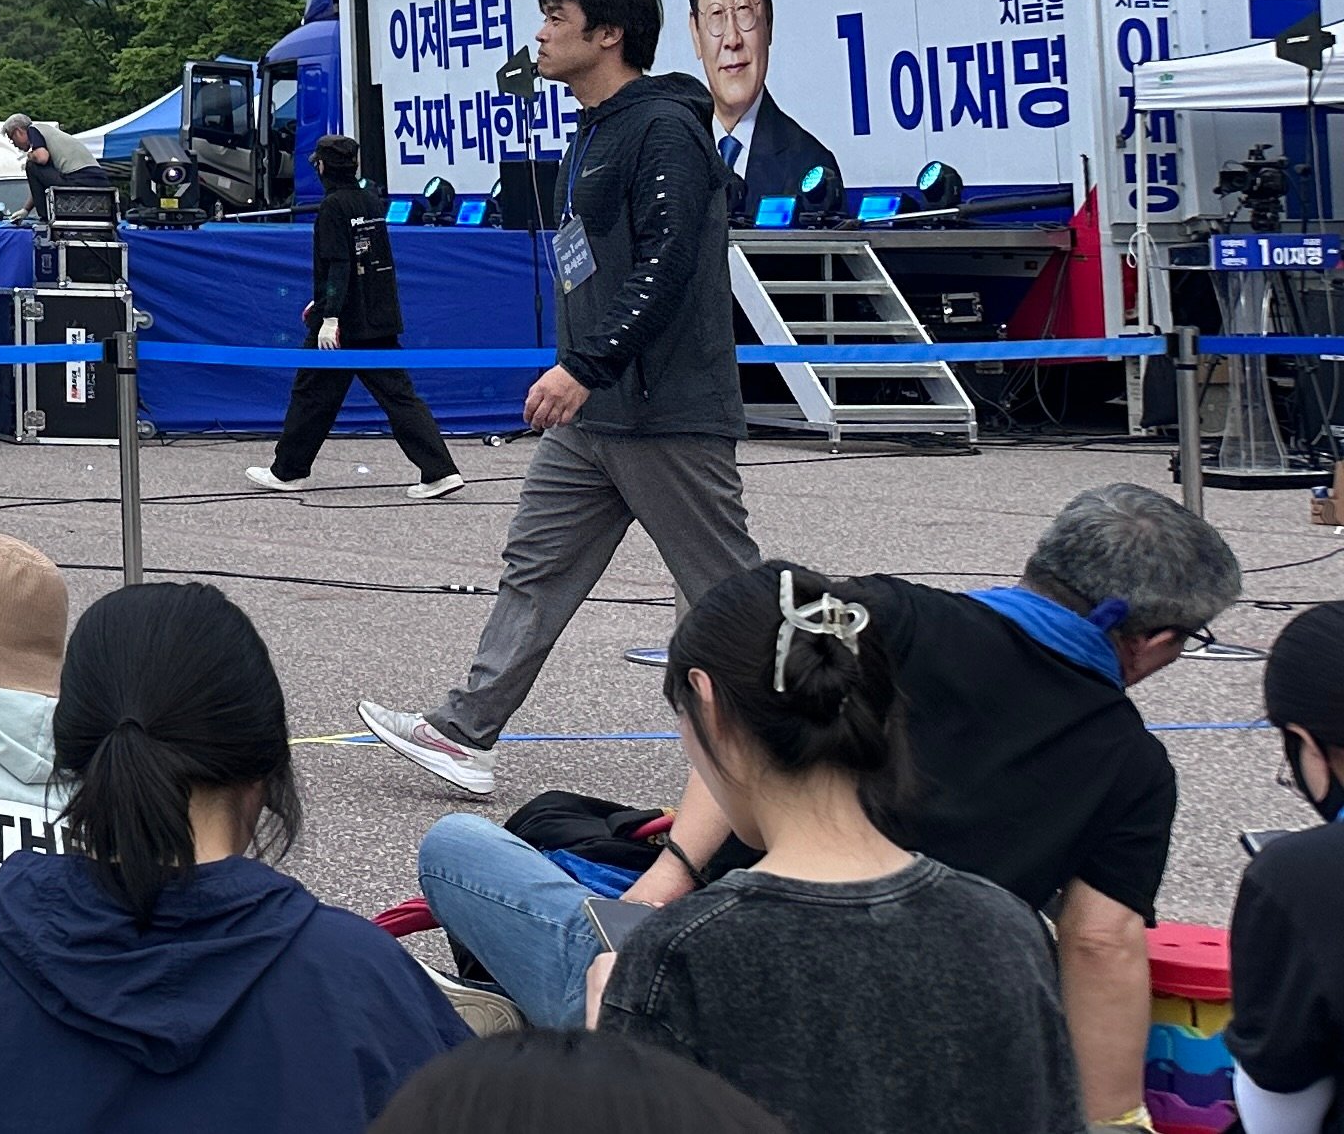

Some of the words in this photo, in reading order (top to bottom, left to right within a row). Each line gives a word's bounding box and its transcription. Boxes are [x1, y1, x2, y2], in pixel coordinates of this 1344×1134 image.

[836, 12, 871, 136] 1
[890, 34, 1070, 132] 이재명
[394, 93, 455, 165] 진짜
[1257, 239, 1270, 265] 1
[1273, 247, 1323, 265] 이재명
